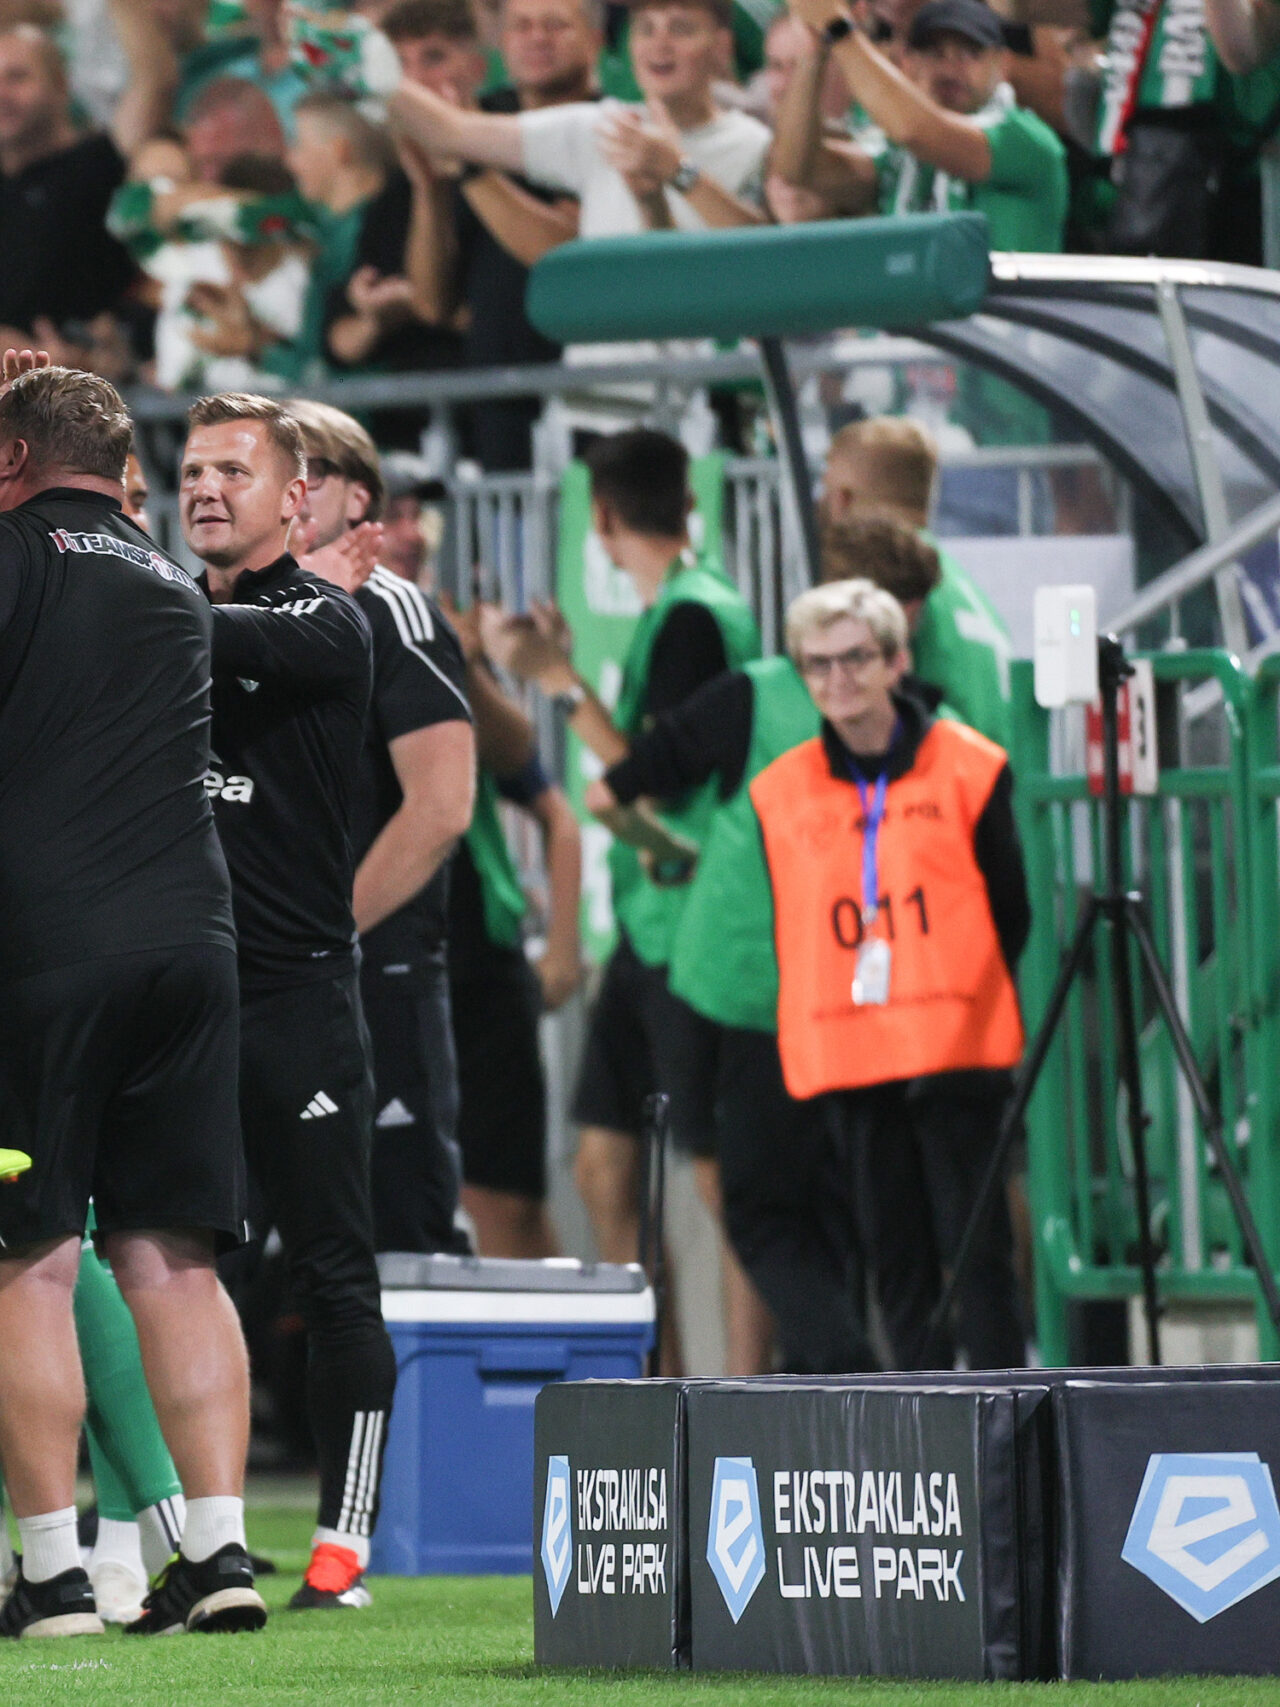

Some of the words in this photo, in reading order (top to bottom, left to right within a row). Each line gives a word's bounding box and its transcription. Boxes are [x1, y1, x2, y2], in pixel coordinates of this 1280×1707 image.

[831, 885, 930, 950] 011
[773, 1470, 962, 1537] EKSTRAKLASA
[622, 1543, 666, 1594] PARK
[873, 1546, 965, 1602] PARK
